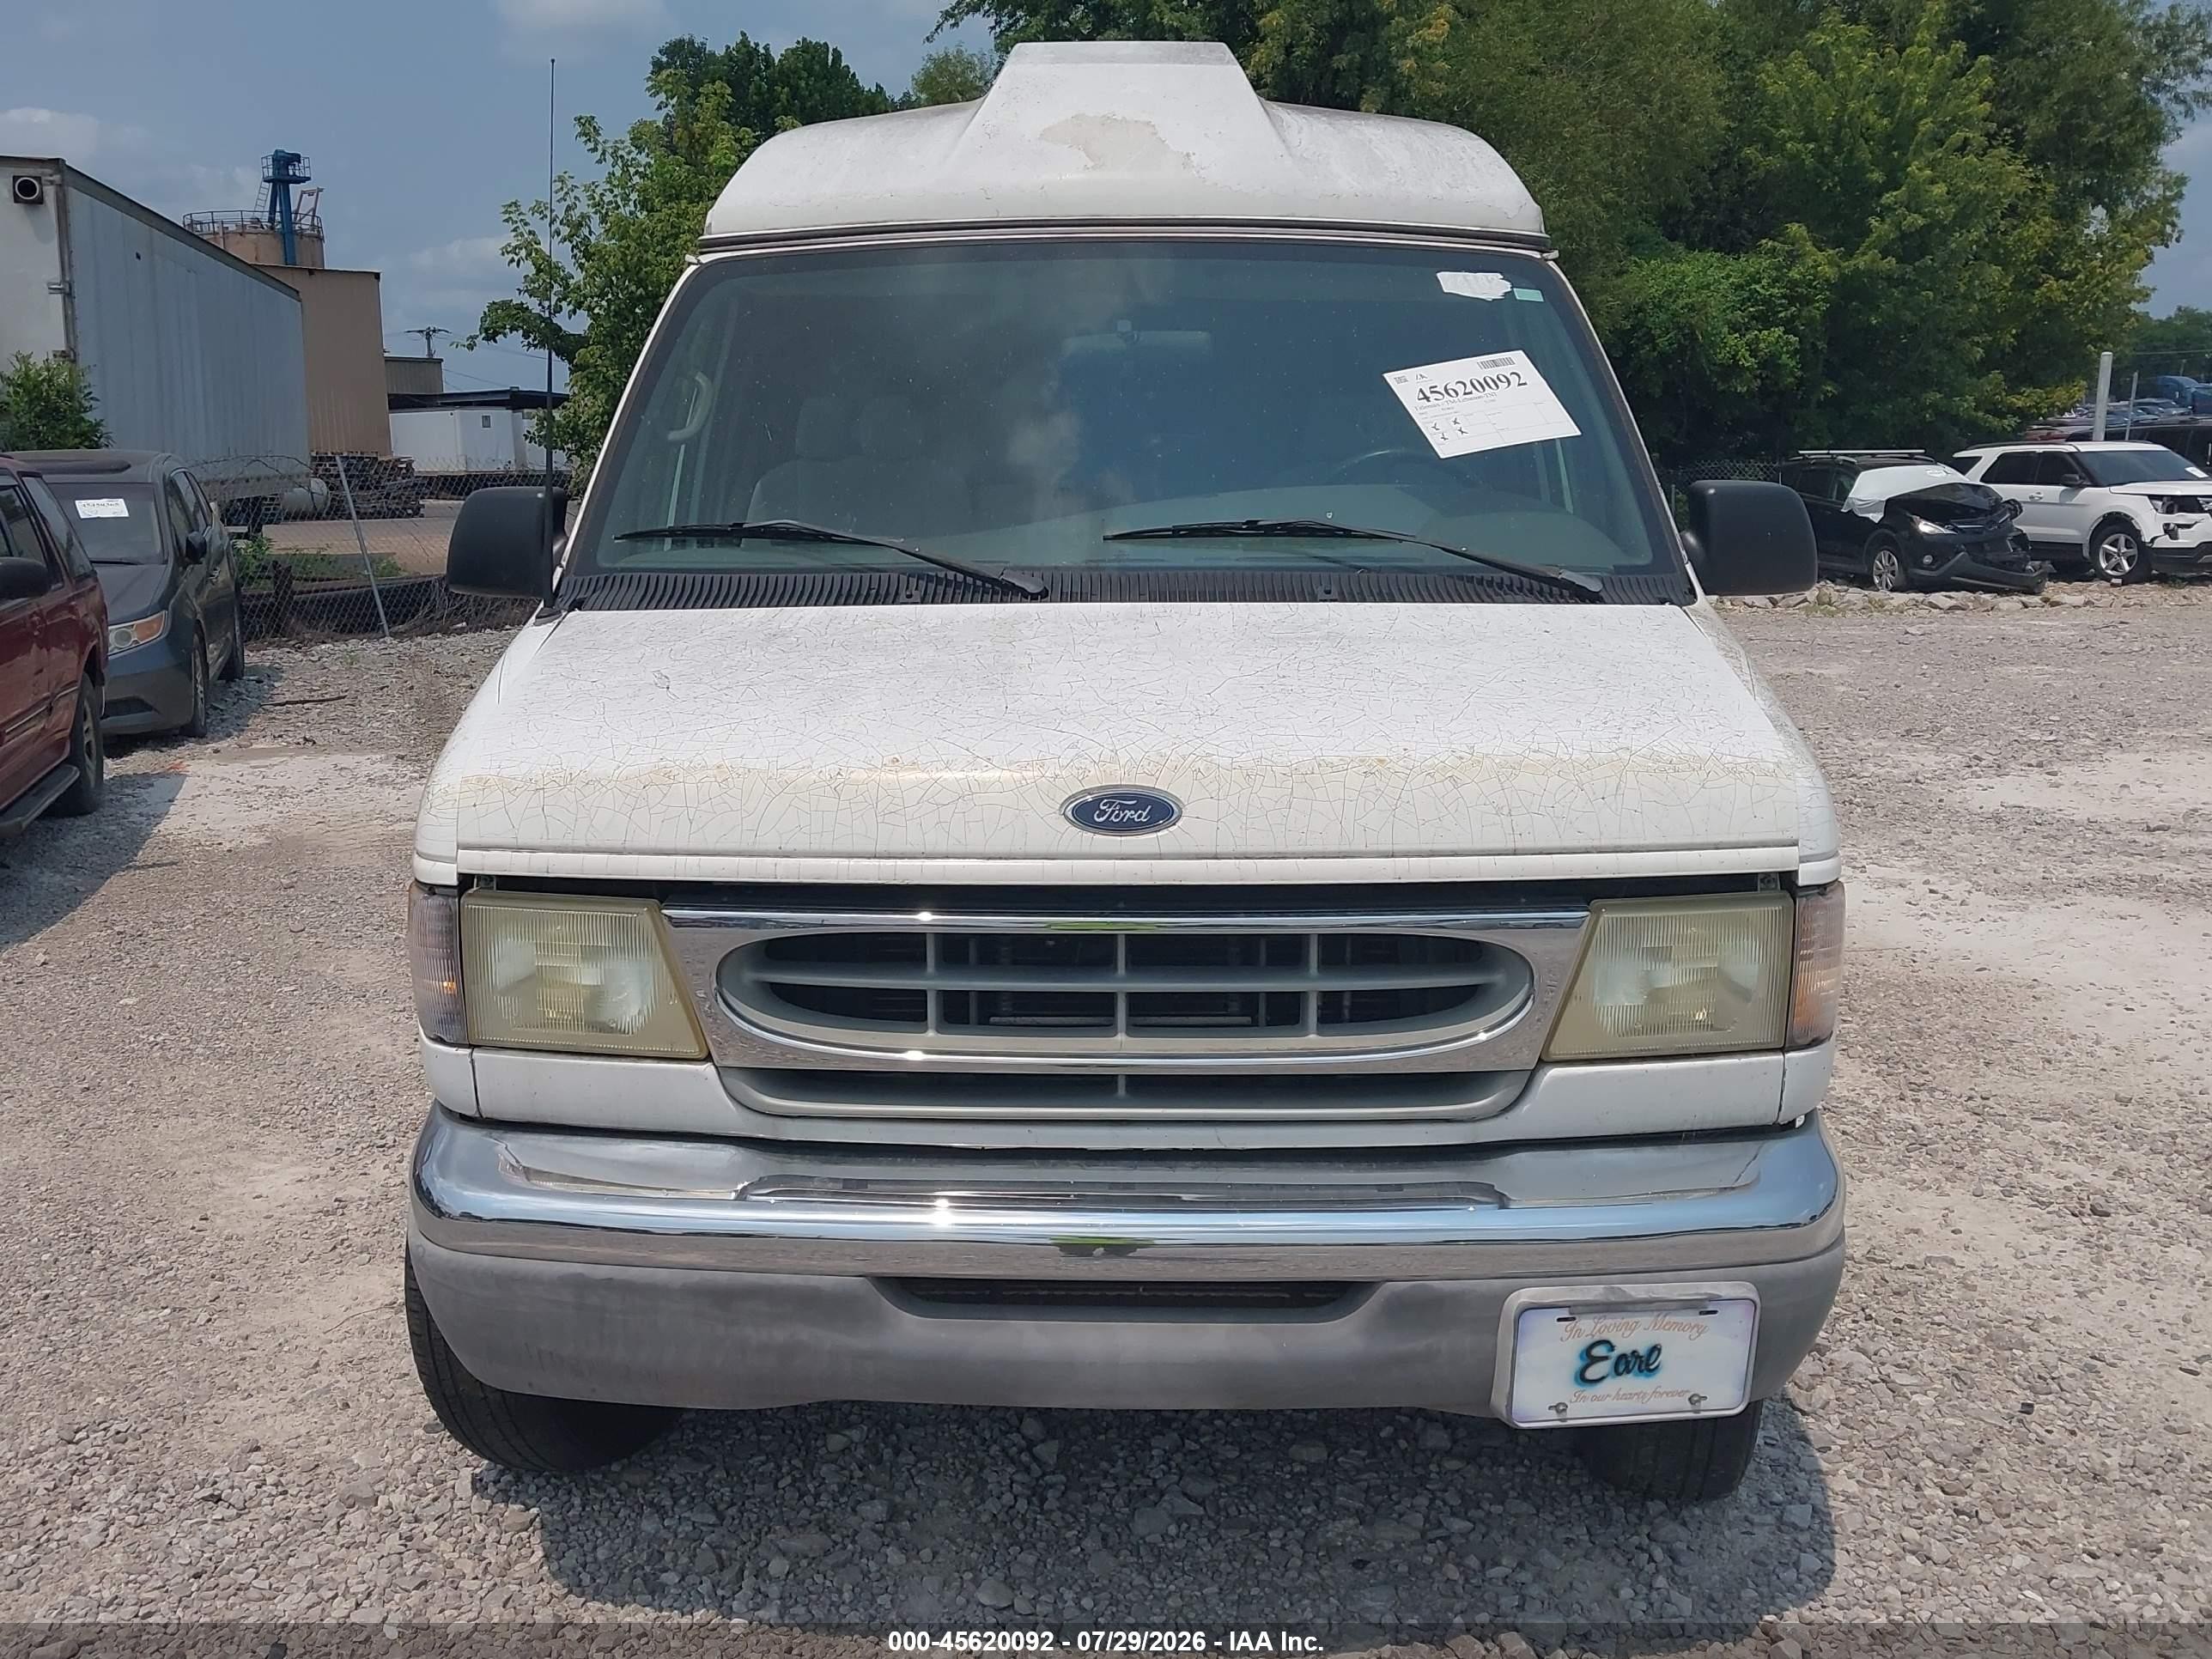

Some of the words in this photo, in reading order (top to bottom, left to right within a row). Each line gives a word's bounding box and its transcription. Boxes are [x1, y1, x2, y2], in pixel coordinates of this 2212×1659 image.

[1417, 372, 1528, 403] 45620092
[1093, 799, 1151, 823] Ford
[1560, 1319, 1585, 1342] In
[1585, 1314, 1641, 1339] Loving
[1644, 1311, 1709, 1340] Memory
[1577, 1340, 1662, 1384] Earl
[1570, 1389, 1589, 1403] In
[1590, 1393, 1611, 1402] our
[1641, 1385, 1691, 1404] forever
